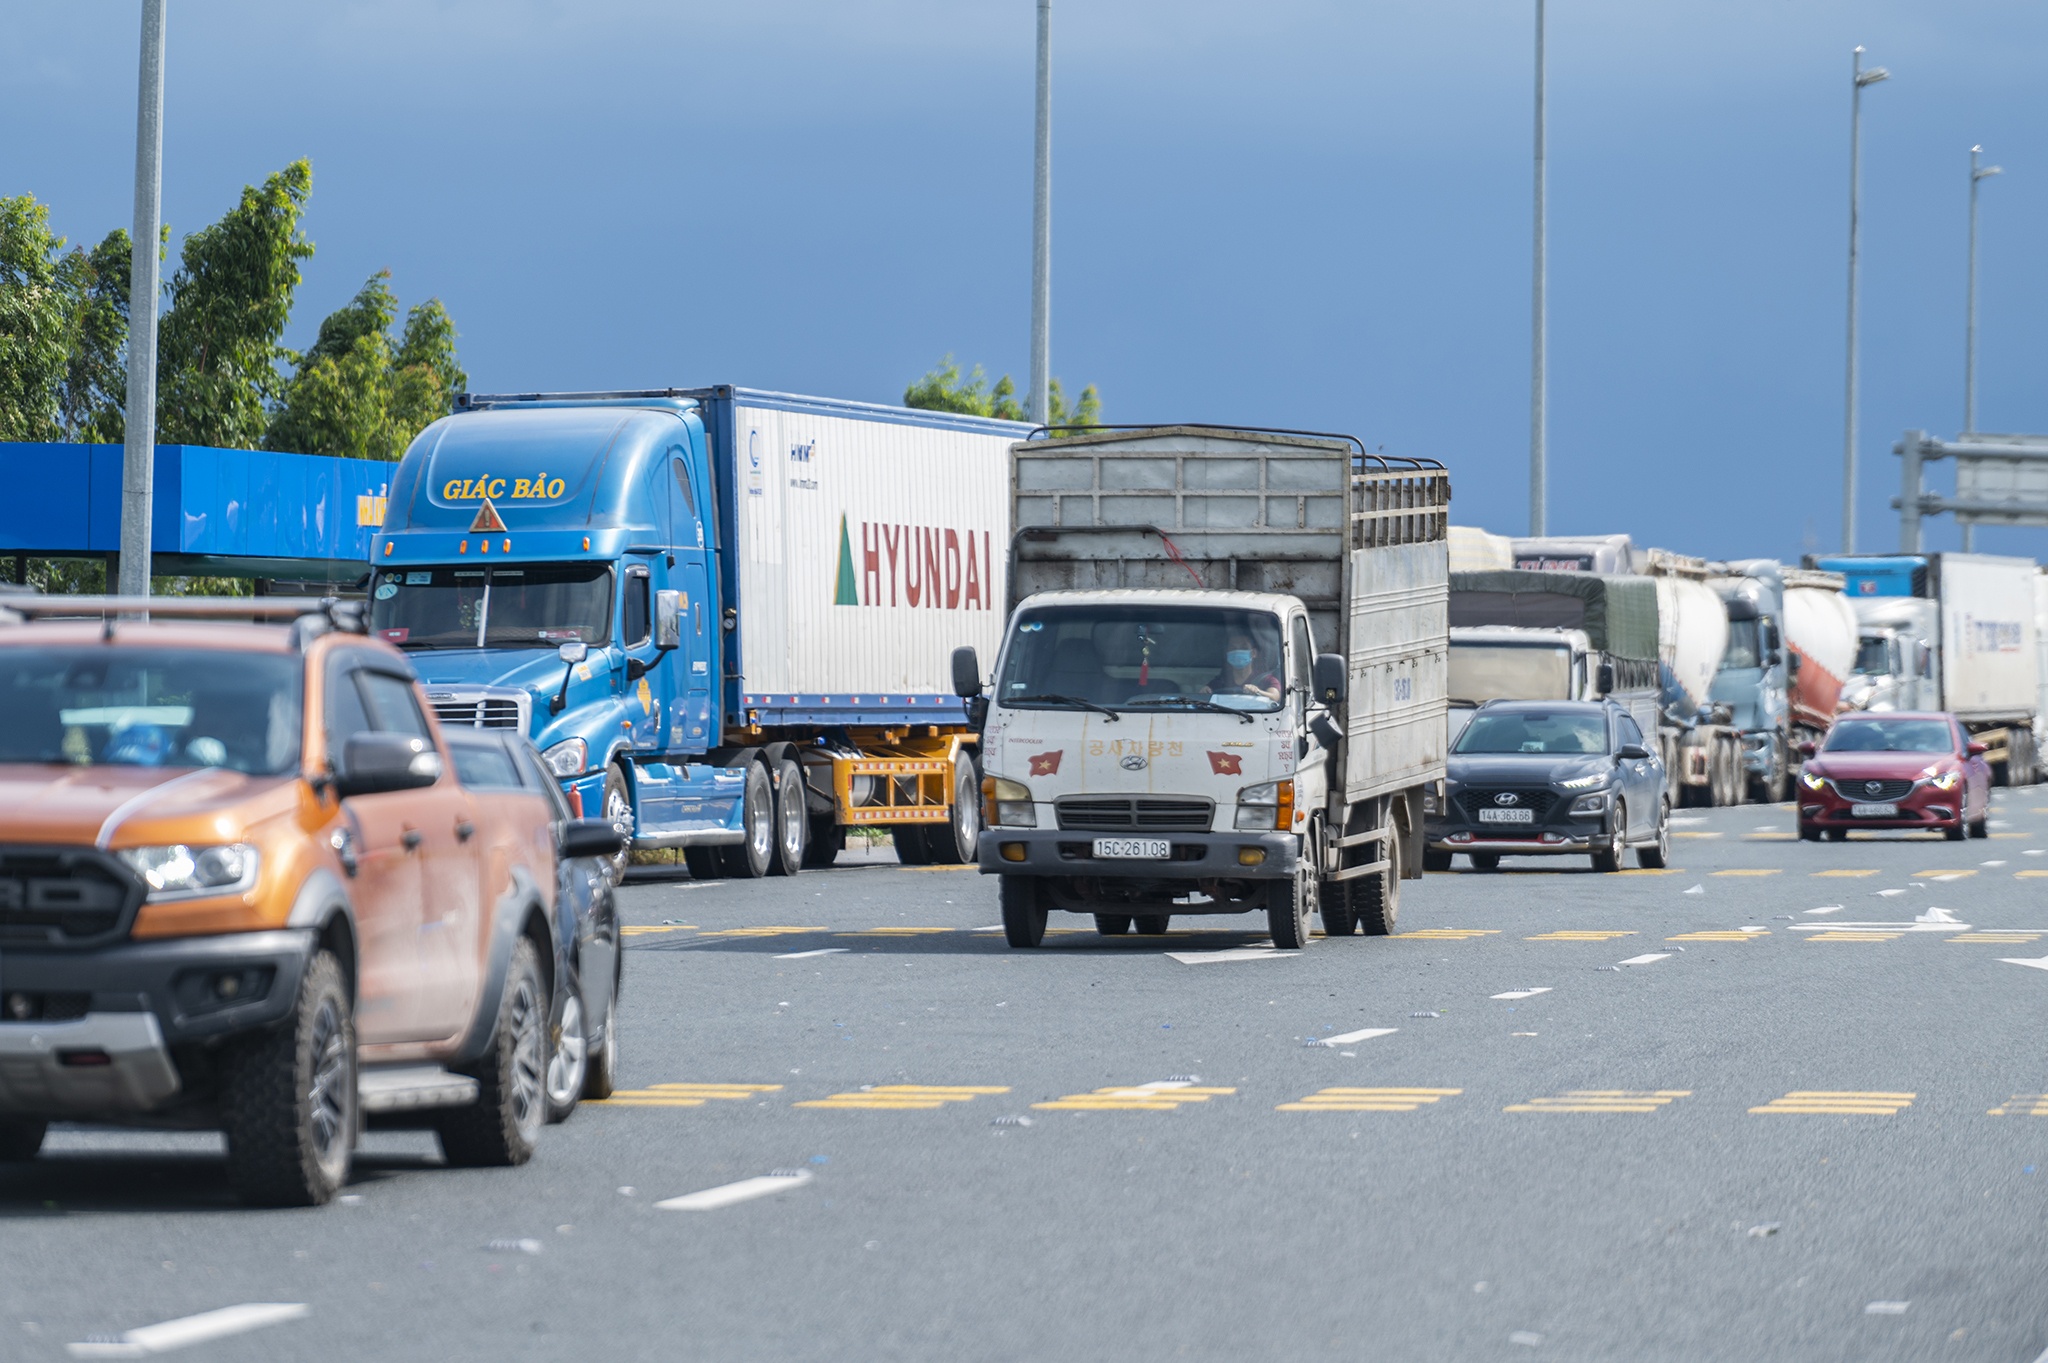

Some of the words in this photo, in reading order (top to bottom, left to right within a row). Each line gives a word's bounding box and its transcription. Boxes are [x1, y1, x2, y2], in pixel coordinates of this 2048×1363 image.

[443, 474, 506, 500] GIÁC
[511, 472, 566, 499] BẢO
[862, 522, 991, 611] HYUNDAI
[1008, 737, 1043, 745] INTERCOOLER
[1097, 841, 1168, 857] 15C-261.08
